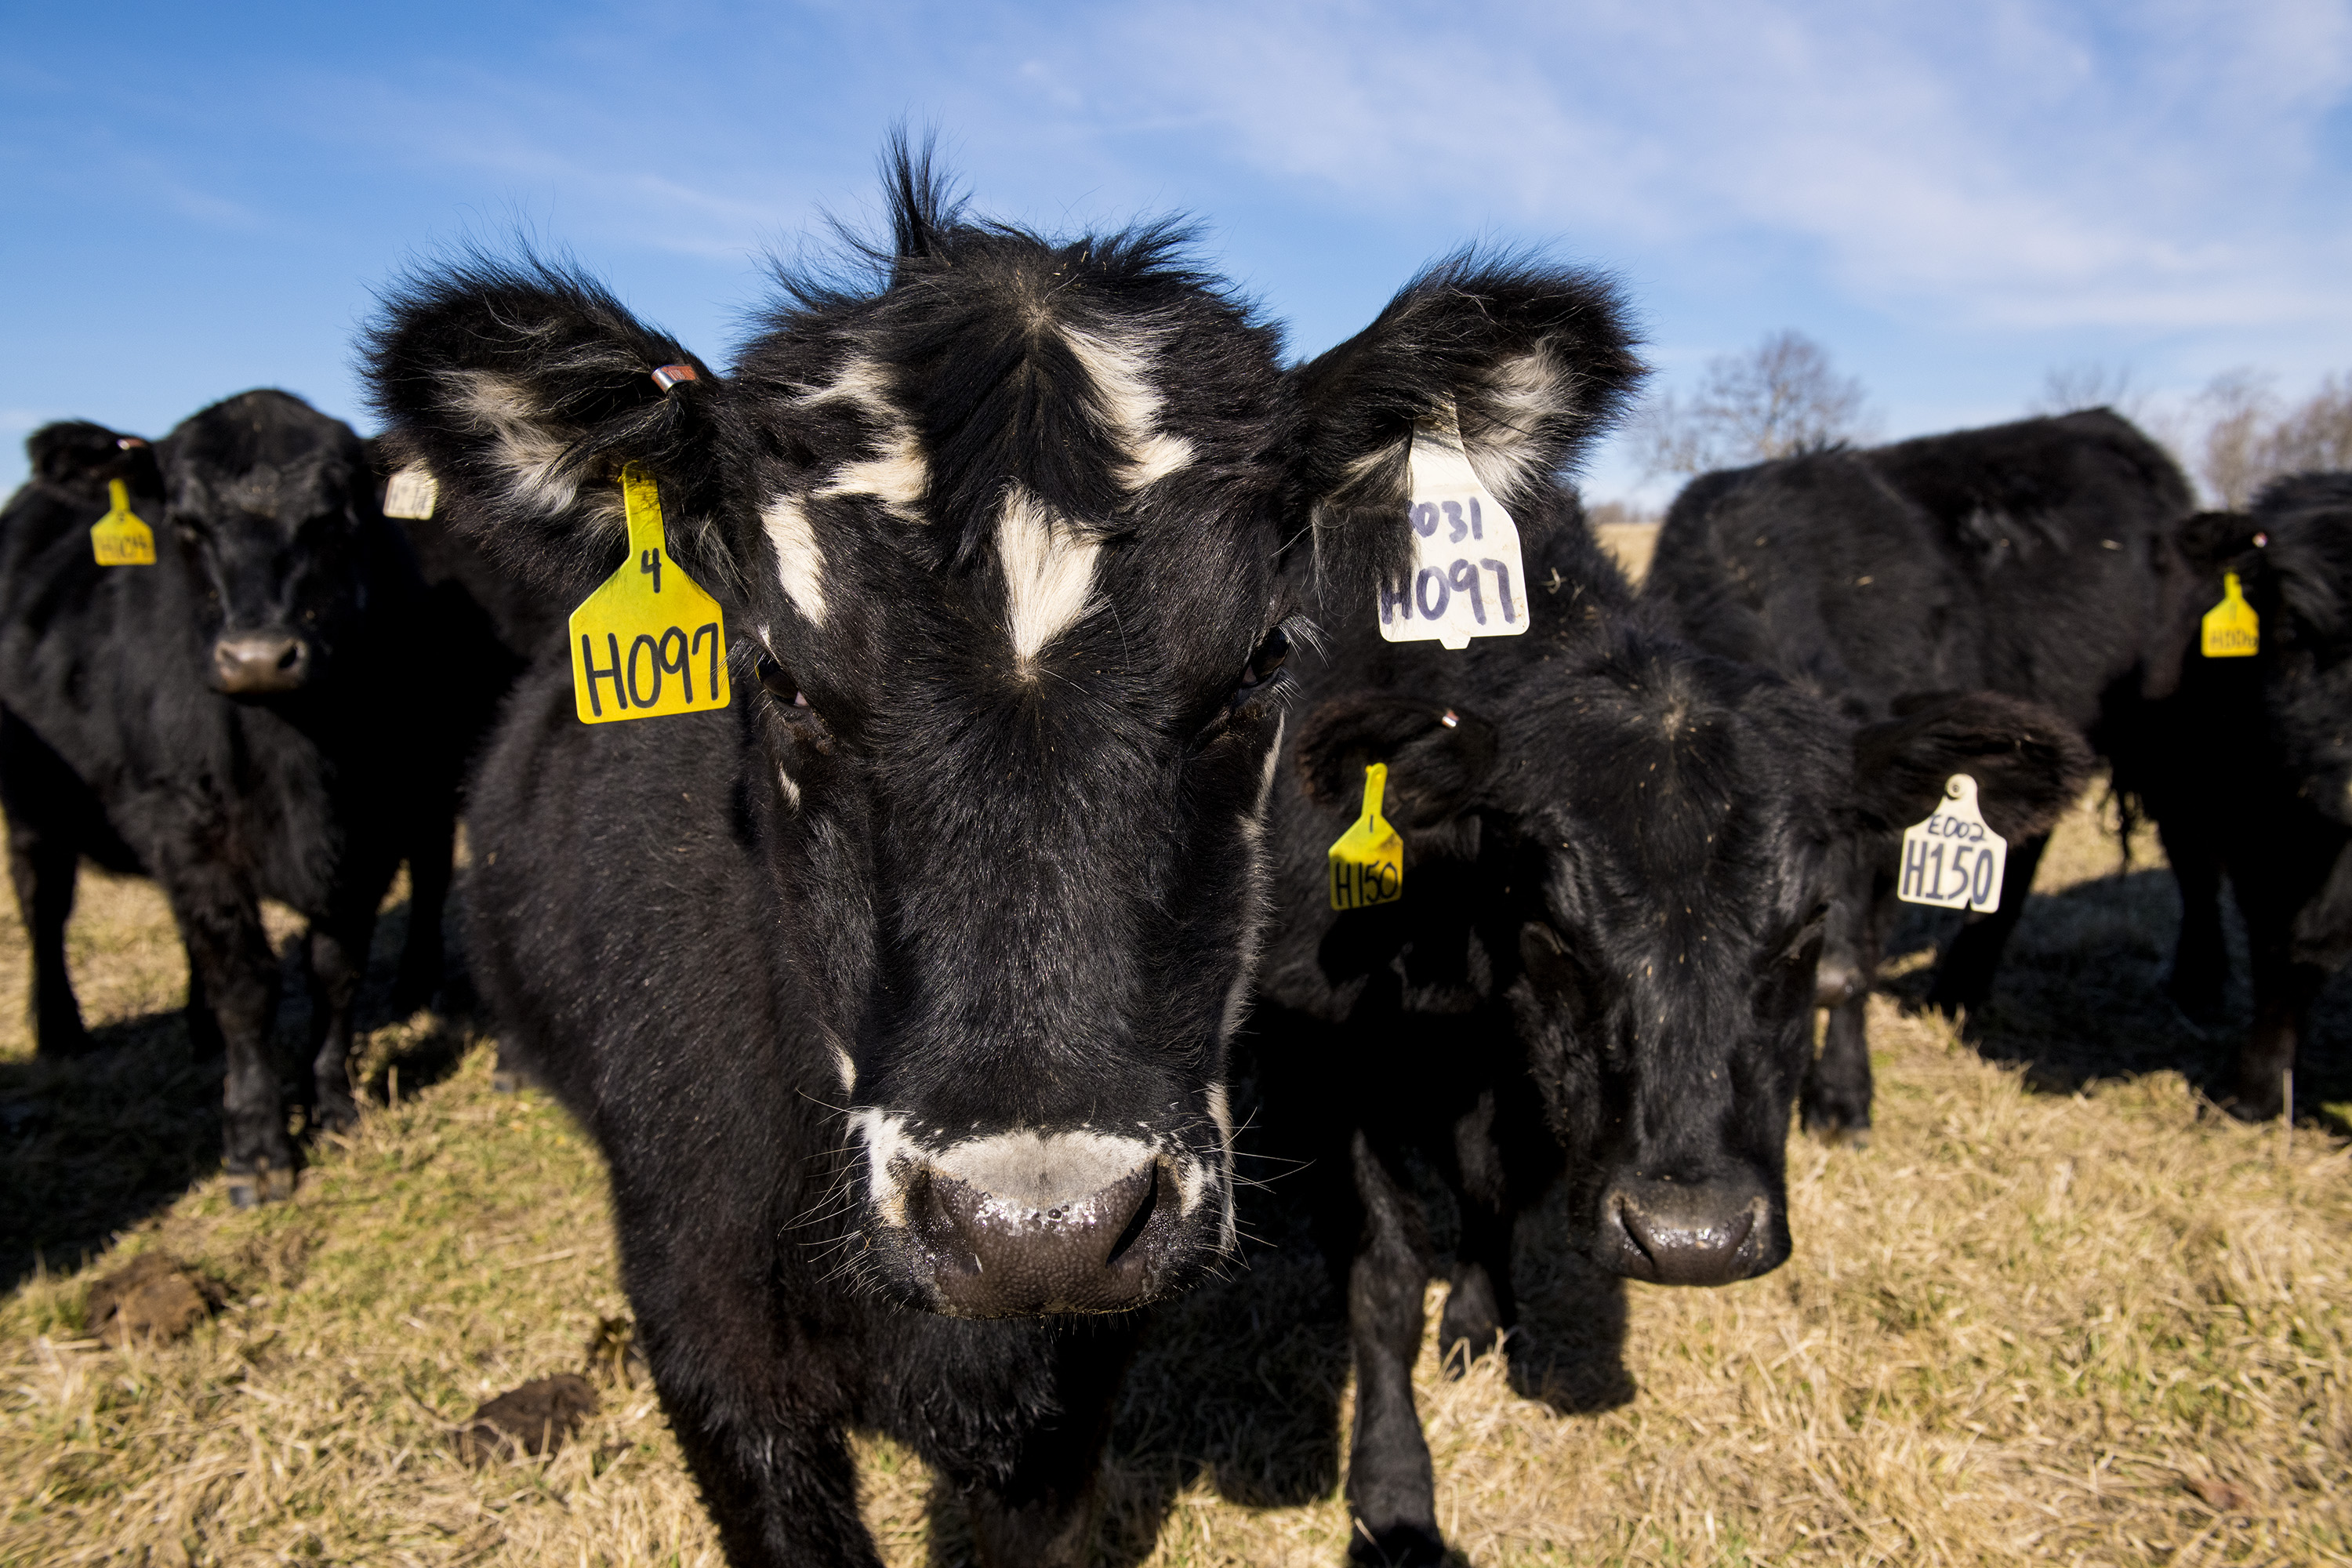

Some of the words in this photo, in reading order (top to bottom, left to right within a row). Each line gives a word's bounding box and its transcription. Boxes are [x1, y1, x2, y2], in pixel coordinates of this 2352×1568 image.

[641, 547, 662, 594] 4
[1381, 557, 1516, 626] H097
[581, 622, 719, 717] H097
[1928, 813, 1987, 842] E002
[1335, 859, 1399, 908] H150
[1902, 839, 1994, 905] H150
